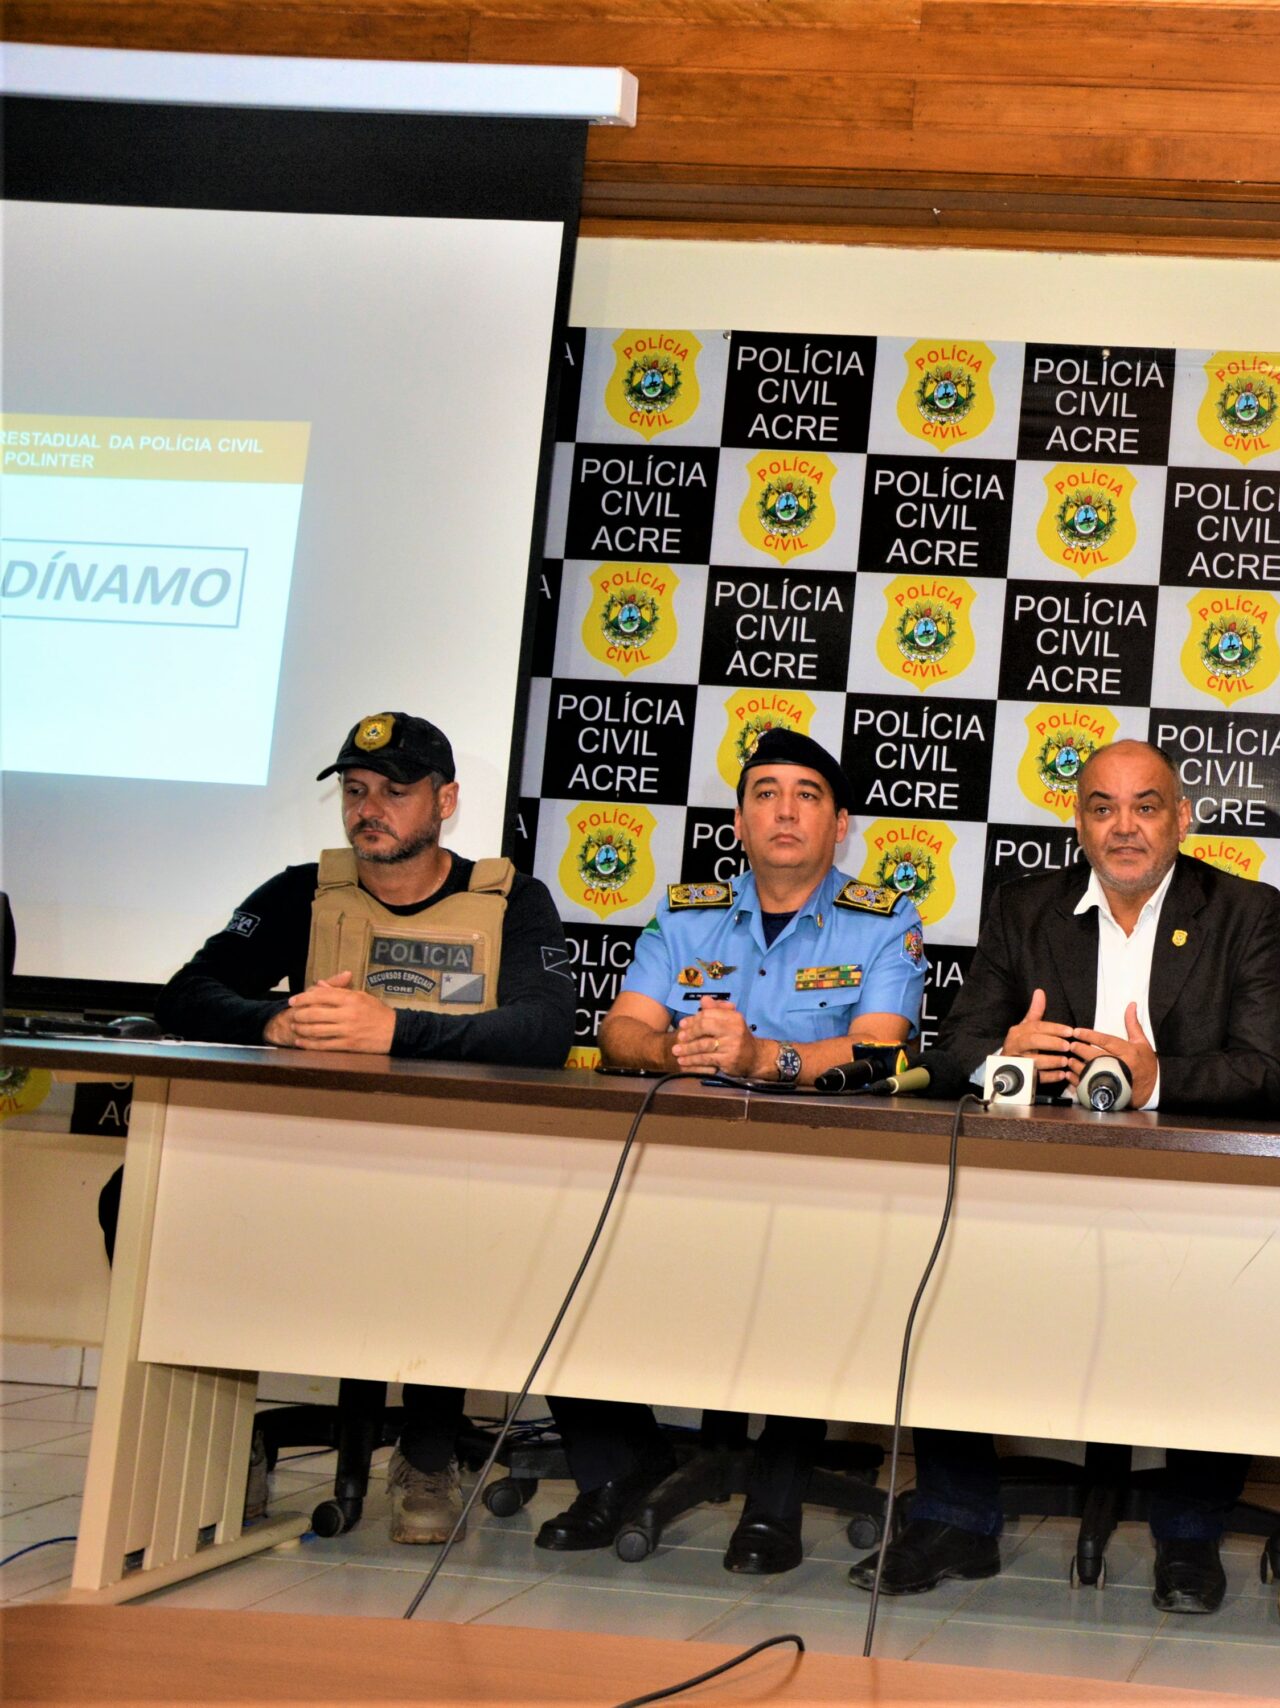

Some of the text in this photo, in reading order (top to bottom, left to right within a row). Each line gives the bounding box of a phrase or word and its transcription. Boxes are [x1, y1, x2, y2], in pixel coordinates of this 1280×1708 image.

[621, 334, 689, 362] POLÍCIA
[737, 344, 864, 376] POLÍCIA
[913, 344, 984, 373] POLÍCIA
[1033, 354, 1163, 387] POLÍCIA
[758, 378, 837, 406] CIVIL
[1055, 389, 1136, 417] CIVIL
[627, 410, 674, 428] CIVIL
[748, 413, 839, 441] ACRE
[921, 421, 969, 440] CIVIL
[109, 434, 134, 449] DA
[140, 433, 212, 451] POLÍCIA
[218, 437, 263, 453] CIVIL
[1045, 425, 1138, 453] ACRE
[1222, 433, 1272, 452] CIVIL
[5, 451, 95, 468] POLINTER
[581, 455, 707, 487] POLÍCIA
[756, 455, 825, 485] POLÍCIA
[874, 466, 1003, 499] POLÍCIA
[1054, 467, 1125, 497] POLÍCIA
[602, 489, 680, 517] CIVIL
[895, 502, 976, 530] CIVIL
[592, 525, 682, 553] ACRE
[762, 533, 810, 552] CIVIL
[1198, 515, 1280, 543] CIVIL
[886, 537, 978, 566] ACRE
[1061, 546, 1111, 565] CIVIL
[1, 550, 232, 608] DÍNAMO
[599, 567, 668, 597] POLÍCIA
[716, 579, 844, 612] POLÍCIA
[894, 580, 965, 610] POLÍCIA
[1015, 592, 1146, 626] POLÍCIA
[1197, 594, 1270, 625] POLÍCIA
[737, 614, 816, 643] CIVIL
[1036, 628, 1118, 657] CIVIL
[605, 645, 652, 664] CIVIL
[727, 650, 819, 679] ACRE
[901, 660, 950, 679] CIVIL
[1027, 665, 1121, 694] ACRE
[1205, 674, 1256, 694] CIVIL
[558, 691, 685, 725] POLÍCIA
[734, 693, 805, 724] POLÍCIA
[854, 706, 984, 741] POLÍCIA
[1035, 708, 1108, 740] POLÍCIA
[578, 727, 657, 756] CIVIL
[875, 742, 956, 772] CIVIL
[568, 763, 659, 793] ACRE
[1180, 758, 1264, 788] CIVIL
[865, 779, 959, 809] ACRE
[1043, 790, 1076, 808] CIV
[575, 807, 645, 838] POLÍCIA
[1190, 796, 1267, 826] CRE
[873, 823, 945, 855] POLÍCIA
[1193, 841, 1251, 871] OLÍCIA
[581, 888, 629, 908] CIVIL
[386, 985, 413, 993] CORE
